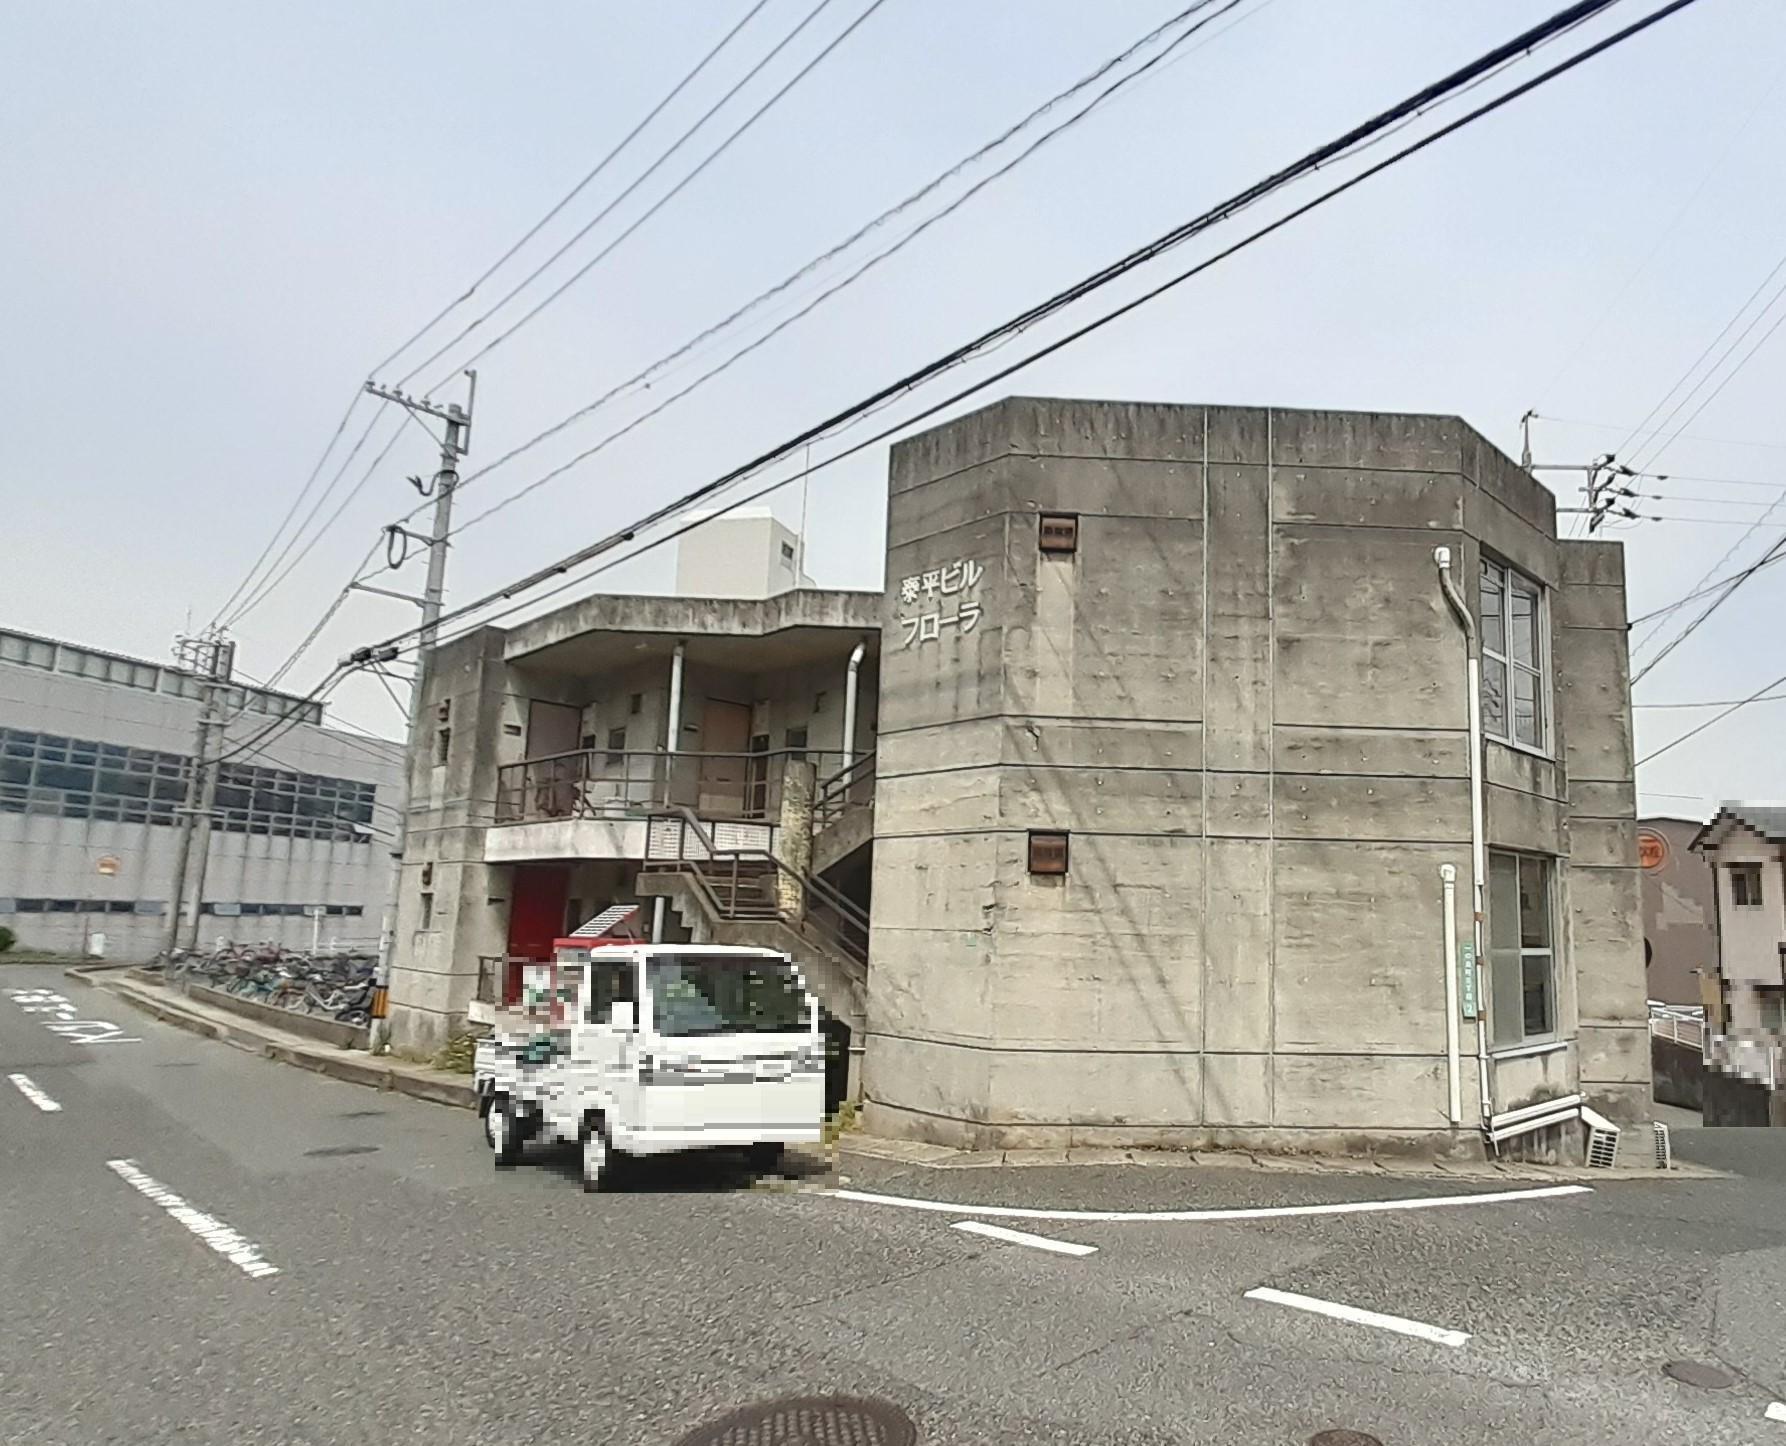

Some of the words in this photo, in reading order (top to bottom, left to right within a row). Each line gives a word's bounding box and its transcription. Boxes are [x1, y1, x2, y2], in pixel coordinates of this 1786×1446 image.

[901, 559, 984, 604] 泰平ビル
[901, 601, 981, 645] フローラ
